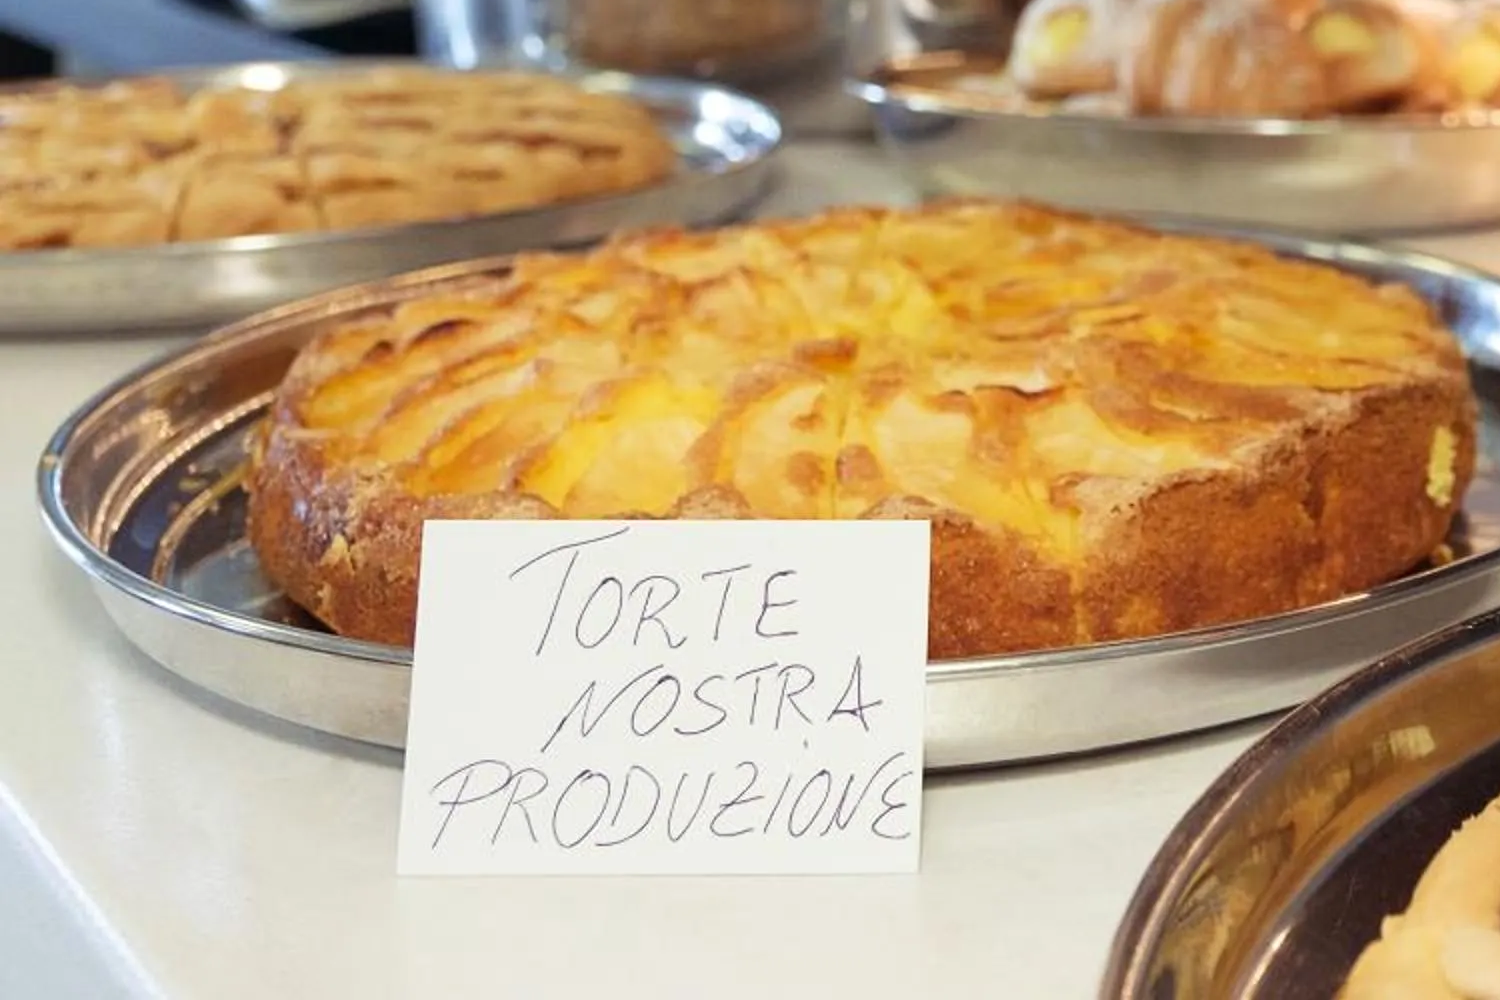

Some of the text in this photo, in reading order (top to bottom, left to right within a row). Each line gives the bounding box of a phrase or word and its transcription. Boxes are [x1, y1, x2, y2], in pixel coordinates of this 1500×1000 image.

[509, 526, 799, 656] TORTE
[540, 655, 884, 753] NOSTRA
[429, 740, 914, 850] PRODUZIONE
